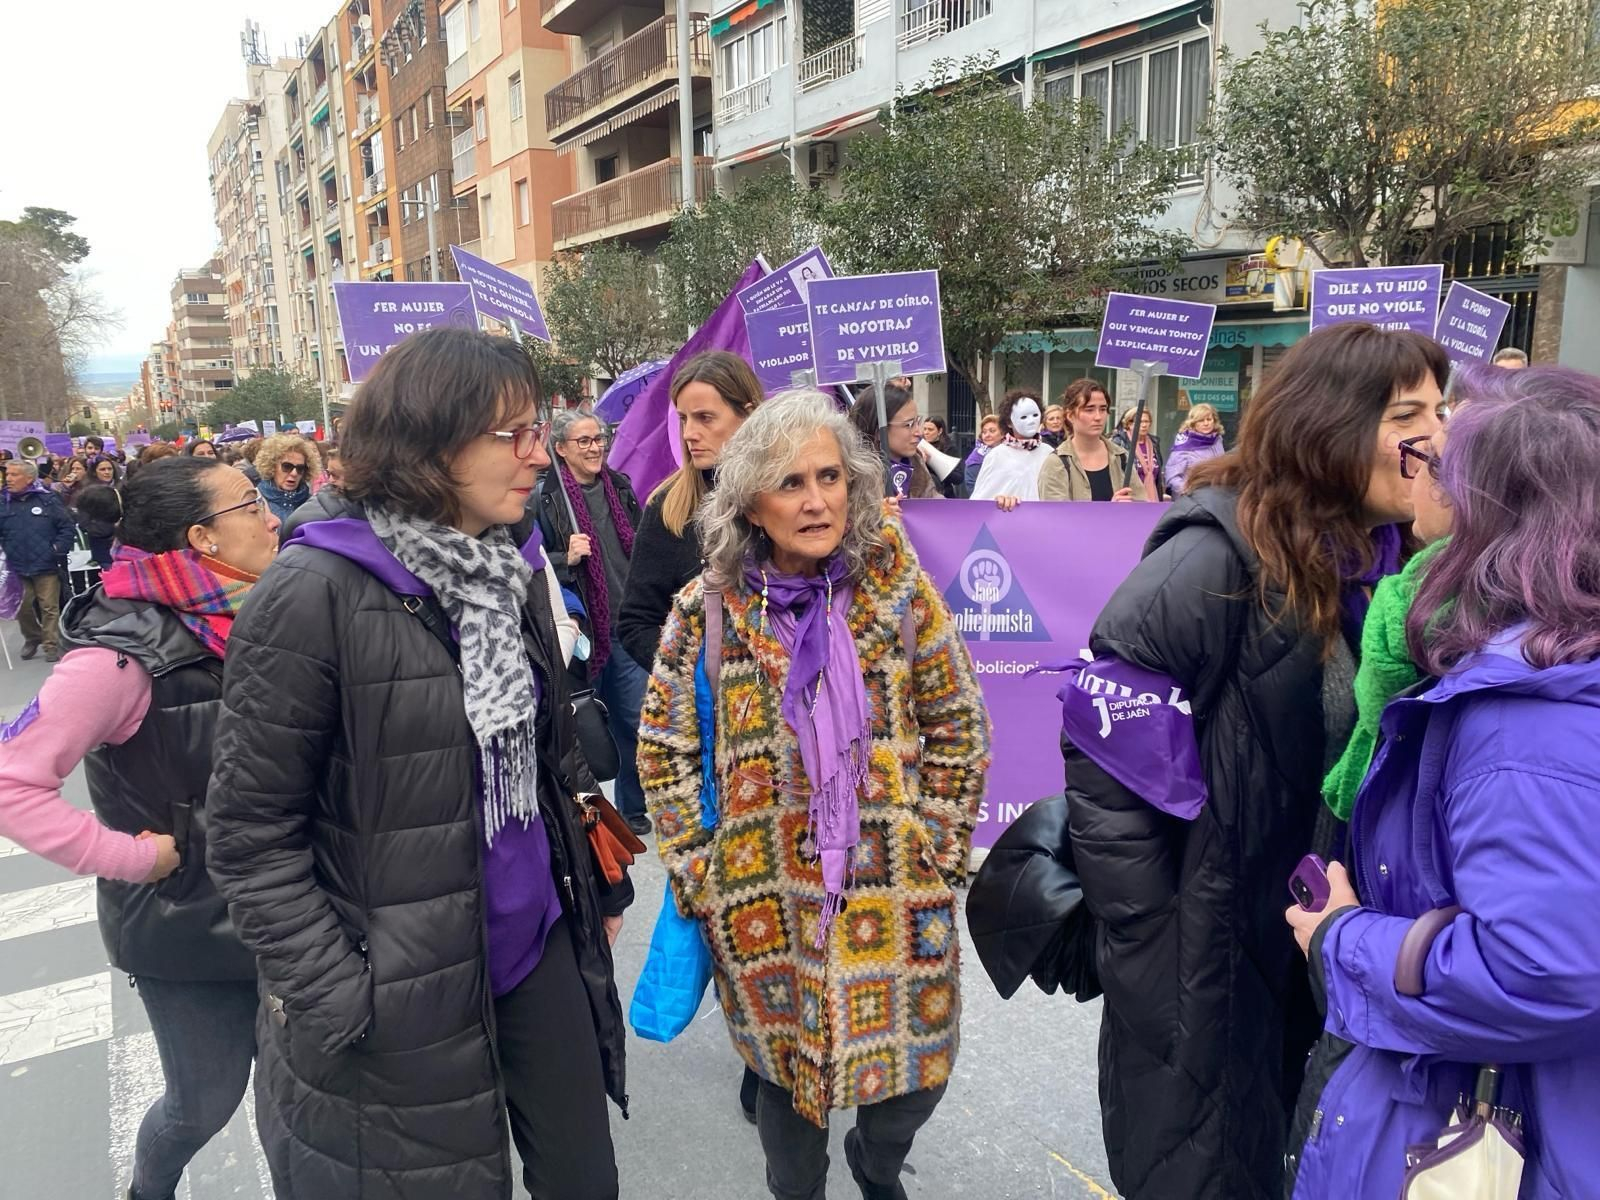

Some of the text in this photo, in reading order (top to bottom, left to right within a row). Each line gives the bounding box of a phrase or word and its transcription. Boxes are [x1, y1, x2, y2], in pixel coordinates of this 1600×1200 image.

[472, 276, 486, 288] NO
[487, 284, 498, 294] TE
[1173, 275, 1219, 292] SECOS
[1328, 280, 1428, 295] DILE A TU HIJO
[373, 302, 445, 312] SER MUJER
[478, 290, 536, 322] TE CONTROLA
[816, 304, 828, 314] TE
[831, 300, 876, 314] CANSAS
[880, 299, 893, 309] DE
[1328, 301, 1426, 316] QUE NO VIOLE,
[1462, 298, 1491, 317] EL PORNO
[1129, 308, 1190, 322] SER MUJER ES
[394, 323, 414, 334] NO
[839, 316, 913, 336] NOSOTRAS
[1388, 322, 1411, 330] HIJA
[1450, 316, 1458, 326] ES
[1457, 319, 1466, 330] LA
[1108, 322, 1204, 340] QUE VENGAN TONTOS
[359, 345, 381, 356] UN
[838, 341, 919, 360] DE VIVIRLO
[1115, 339, 1168, 352] EXPLICARTE
[1170, 346, 1200, 356] COSAS
[1441, 336, 1484, 358] LA VIOLACIÓN
[758, 352, 808, 368] VIOLADOR
[1182, 377, 1234, 386] DISPONIBLE
[972, 582, 999, 602] Jaén
[1112, 708, 1150, 721] DE JAÉN
